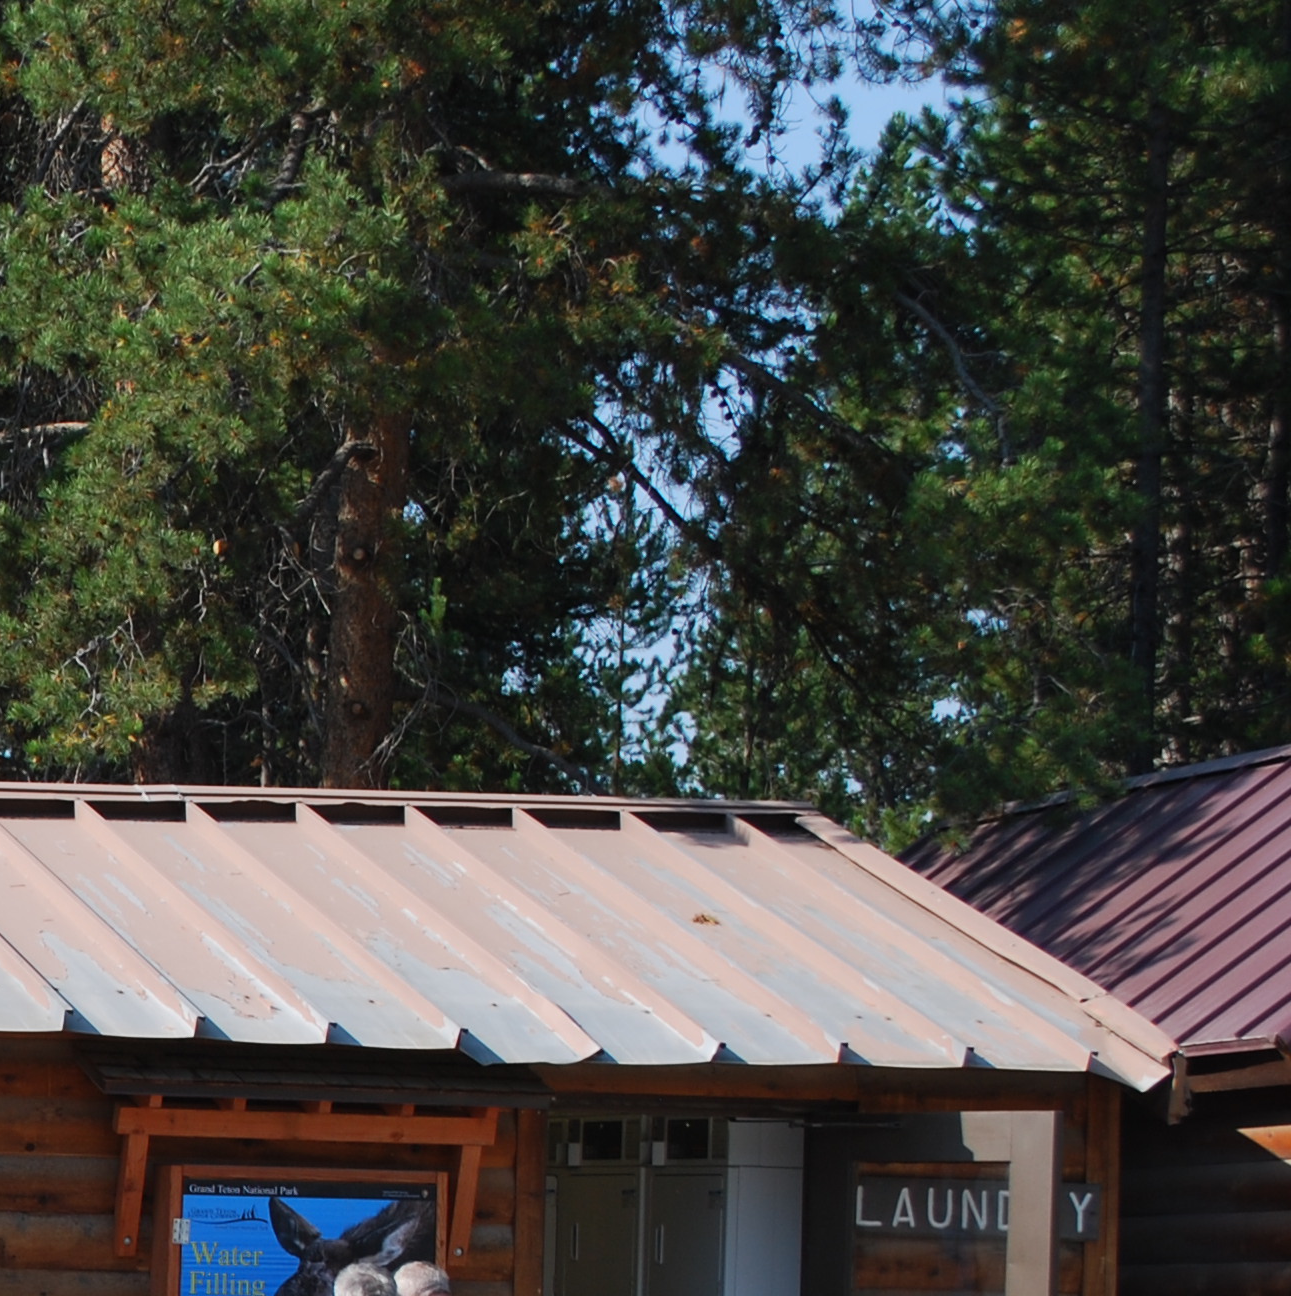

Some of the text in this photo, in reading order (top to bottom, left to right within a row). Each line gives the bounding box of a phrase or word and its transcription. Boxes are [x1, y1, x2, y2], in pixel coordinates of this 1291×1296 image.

[189, 1184, 299, 1196] Grand Teton National Park
[855, 1185, 1093, 1233] LAUNDY
[190, 1241, 264, 1266] Water
